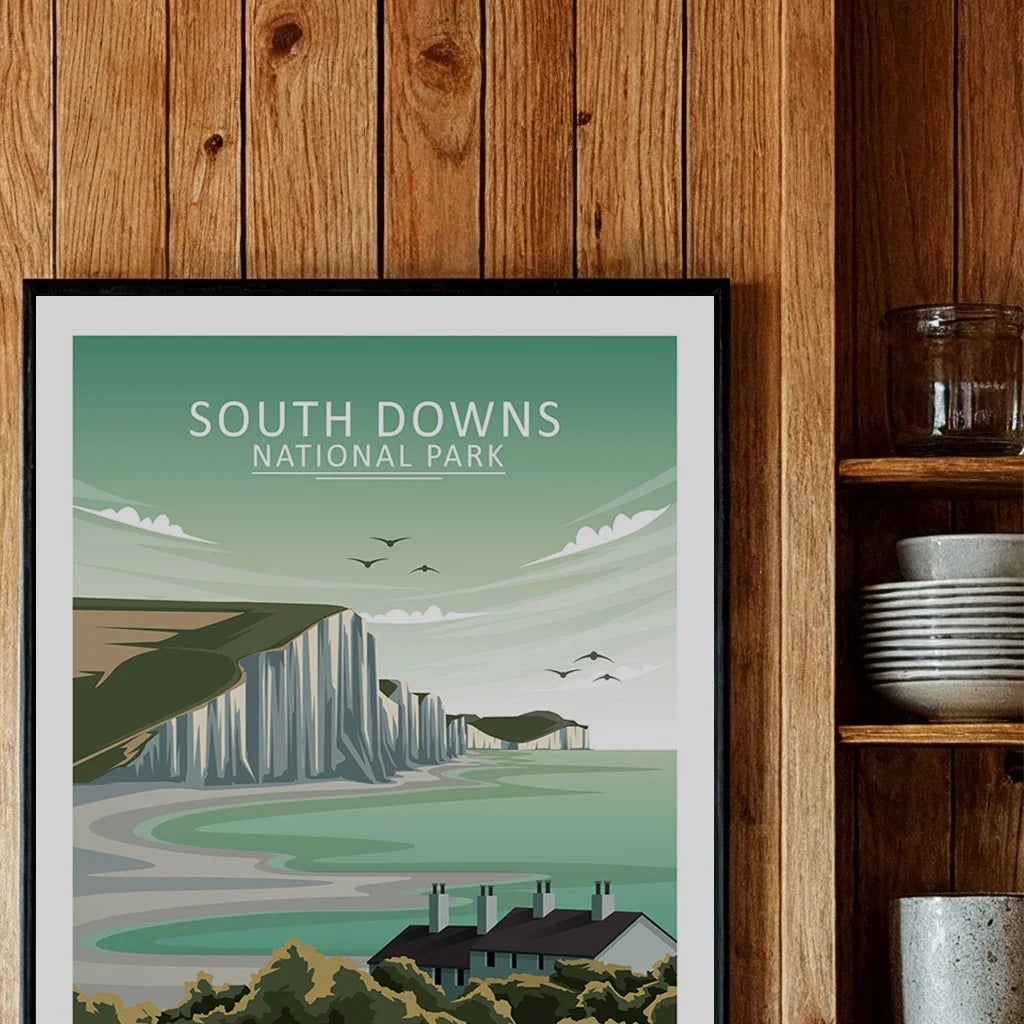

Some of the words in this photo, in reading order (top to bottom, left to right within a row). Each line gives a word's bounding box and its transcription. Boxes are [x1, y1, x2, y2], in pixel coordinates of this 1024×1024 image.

[189, 400, 352, 438] SOUTH
[377, 400, 561, 438] DOWNS
[253, 443, 413, 468] NATIONAL
[427, 443, 504, 468] PARK
